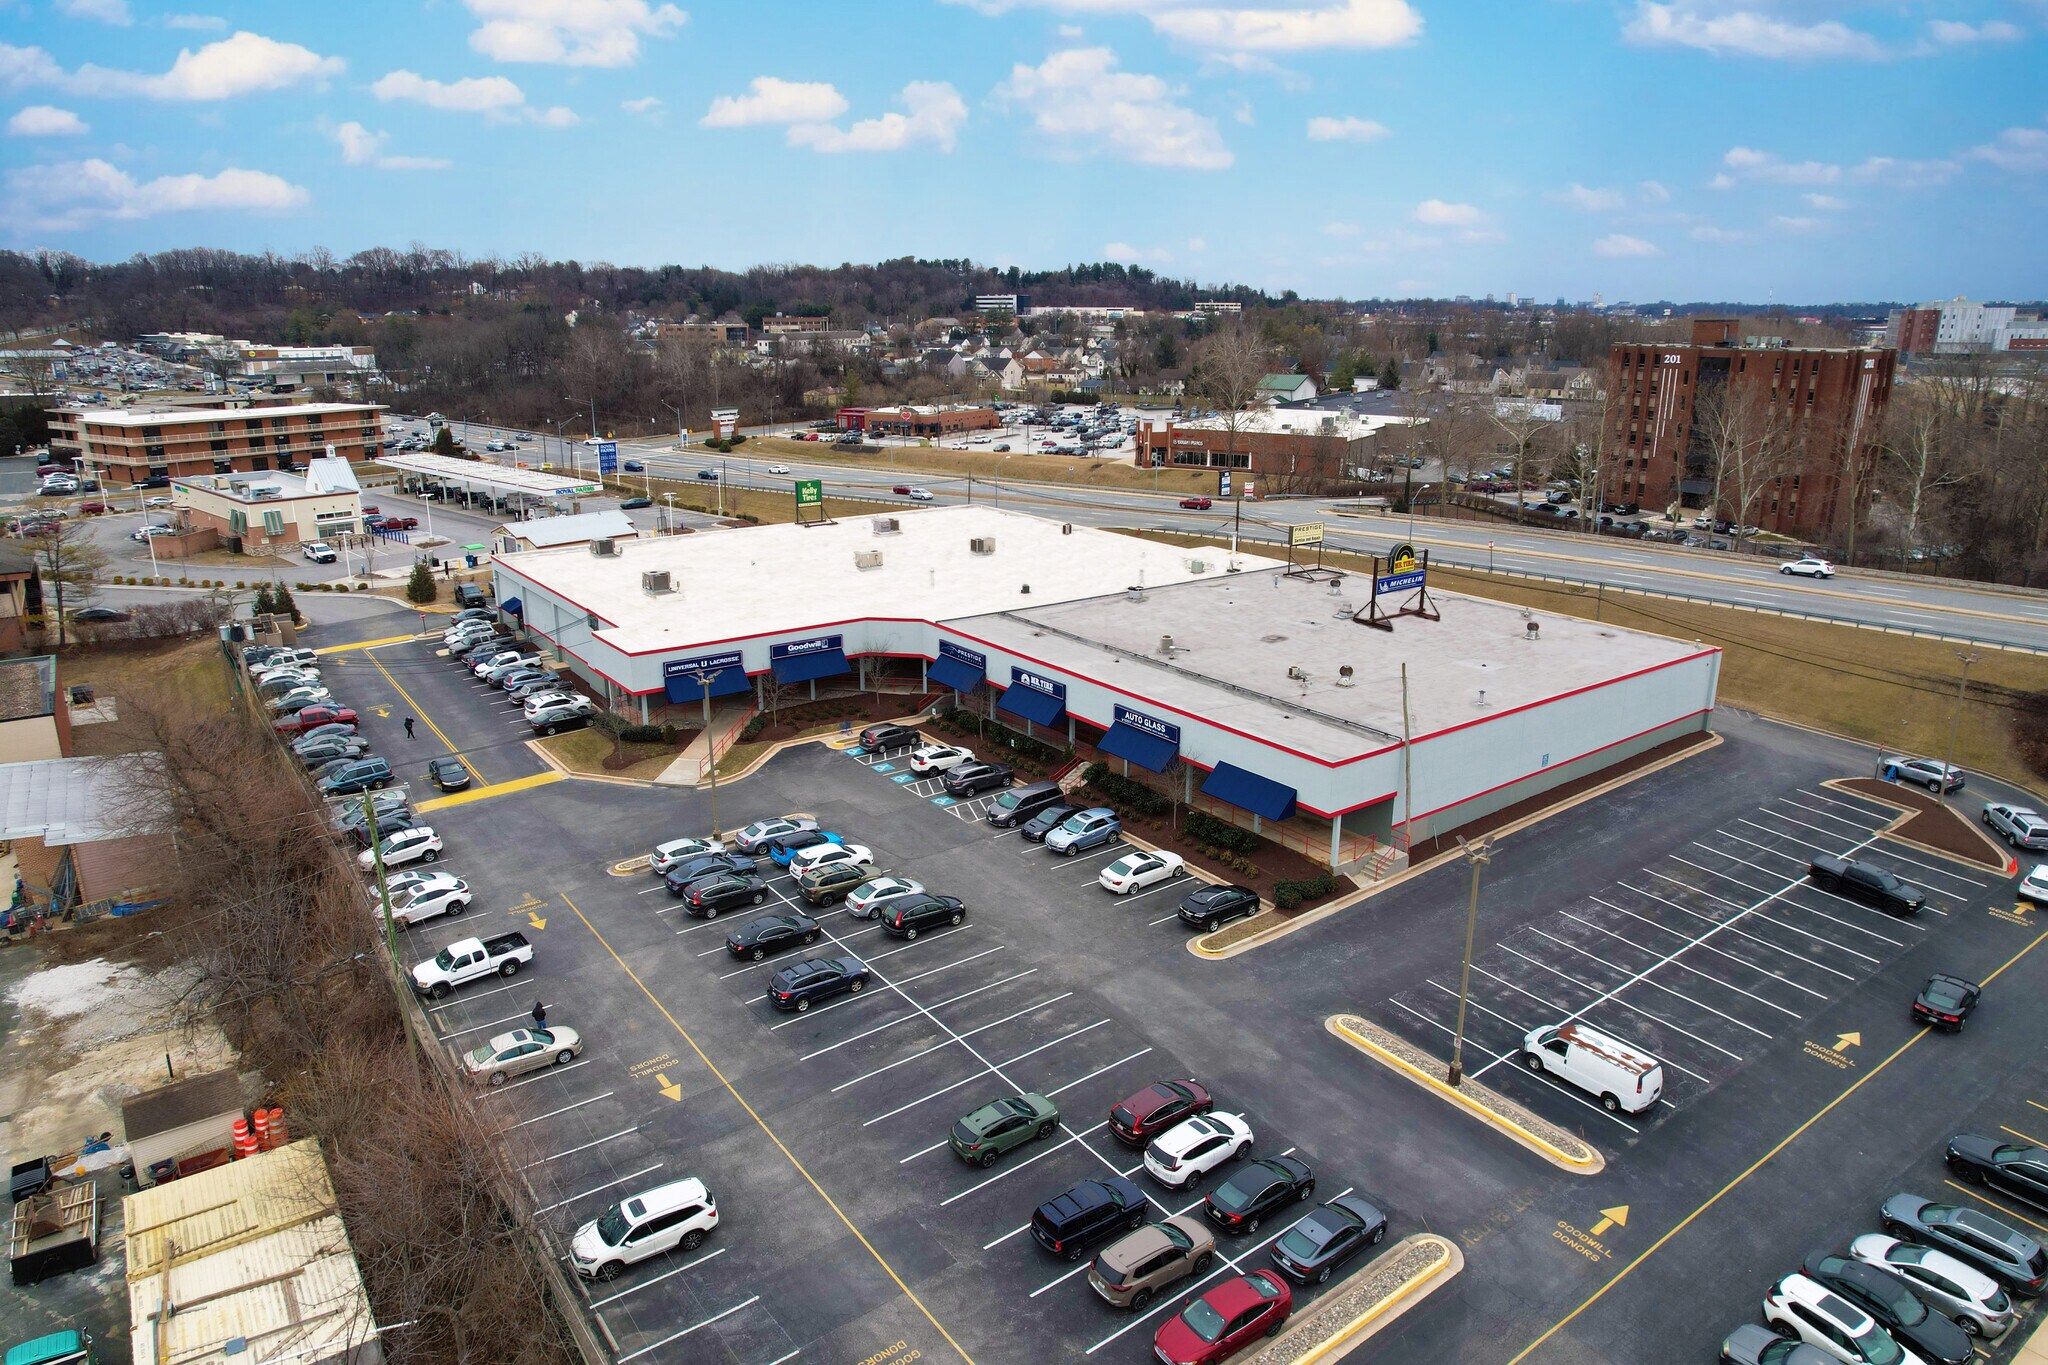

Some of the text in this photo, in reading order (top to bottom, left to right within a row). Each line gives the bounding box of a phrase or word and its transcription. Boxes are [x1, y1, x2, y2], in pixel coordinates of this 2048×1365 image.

[1664, 354, 1681, 364] 201
[802, 487, 818, 495] Kelly
[1294, 524, 1322, 532] PRESTIGE
[1403, 559, 1414, 567] TIRE
[1390, 576, 1424, 587] MICHELIN
[788, 640, 821, 651] Goodwill
[957, 649, 982, 662] PRESTIGE
[668, 662, 700, 672] UNIVERSAL
[709, 656, 740, 665] LACROSSE
[1040, 680, 1054, 691] TIRE
[1125, 711, 1143, 724] AUTO
[1144, 718, 1166, 733] GLASS
[508, 899, 541, 911] DONORS
[508, 902, 549, 916] GOODWILL
[1989, 906, 2036, 925] GOODWILL
[1989, 911, 2028, 927] DONORS
[1803, 1047, 1847, 1069] DONORS
[1804, 1040, 1856, 1067] GOODWILL
[629, 1053, 670, 1072] DONORS
[630, 1058, 679, 1078] GOODWILL
[1552, 1230, 1600, 1262] DONORS
[1557, 1220, 1612, 1259] GOODWILL
